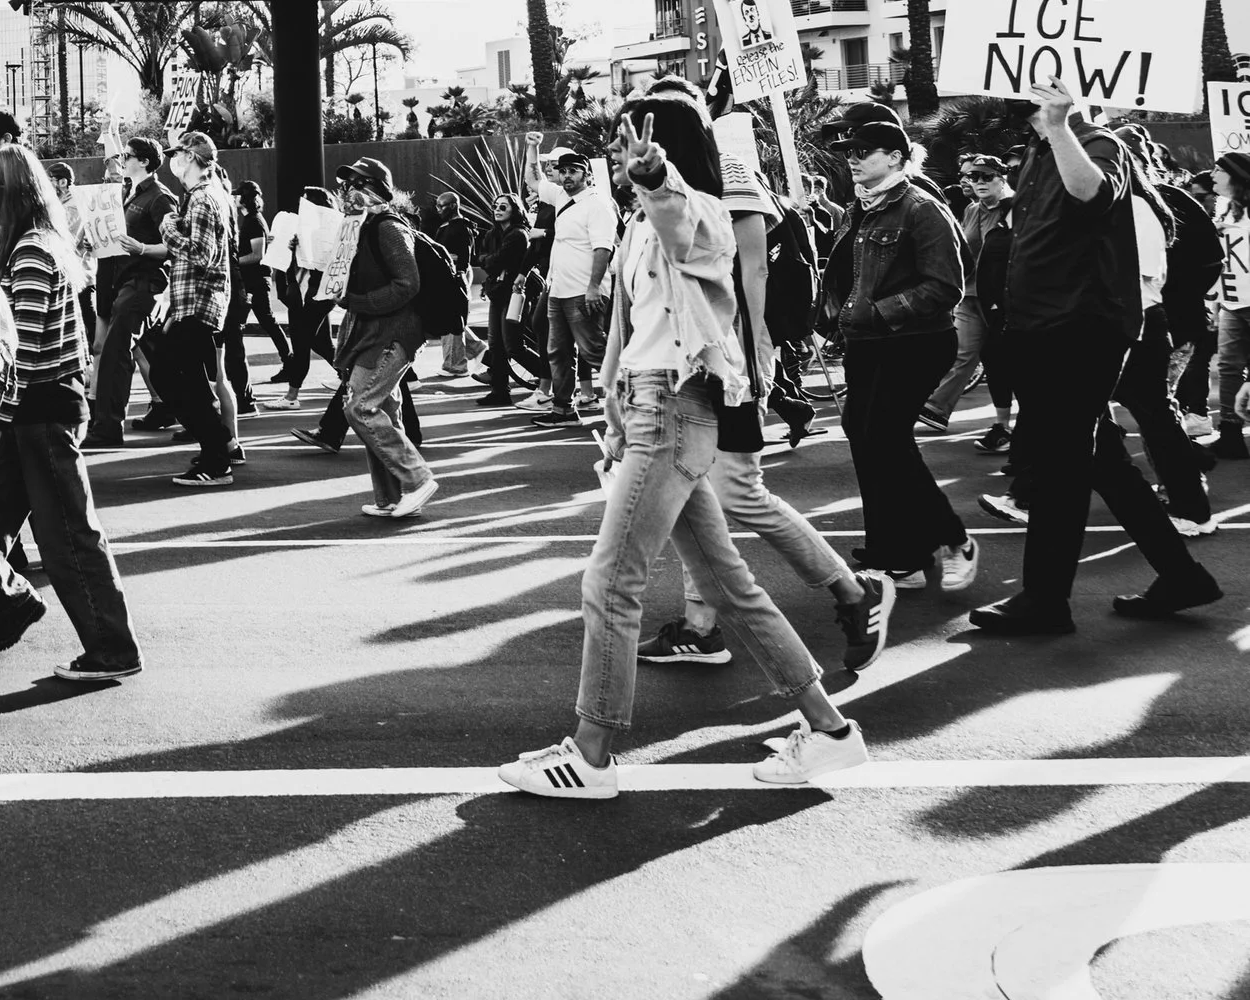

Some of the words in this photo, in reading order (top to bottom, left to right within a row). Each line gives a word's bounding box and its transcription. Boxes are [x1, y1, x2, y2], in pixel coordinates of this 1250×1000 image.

[733, 56, 779, 86] EPSTEIN
[983, 43, 1153, 106] NOW!
[166, 101, 192, 129] ICE
